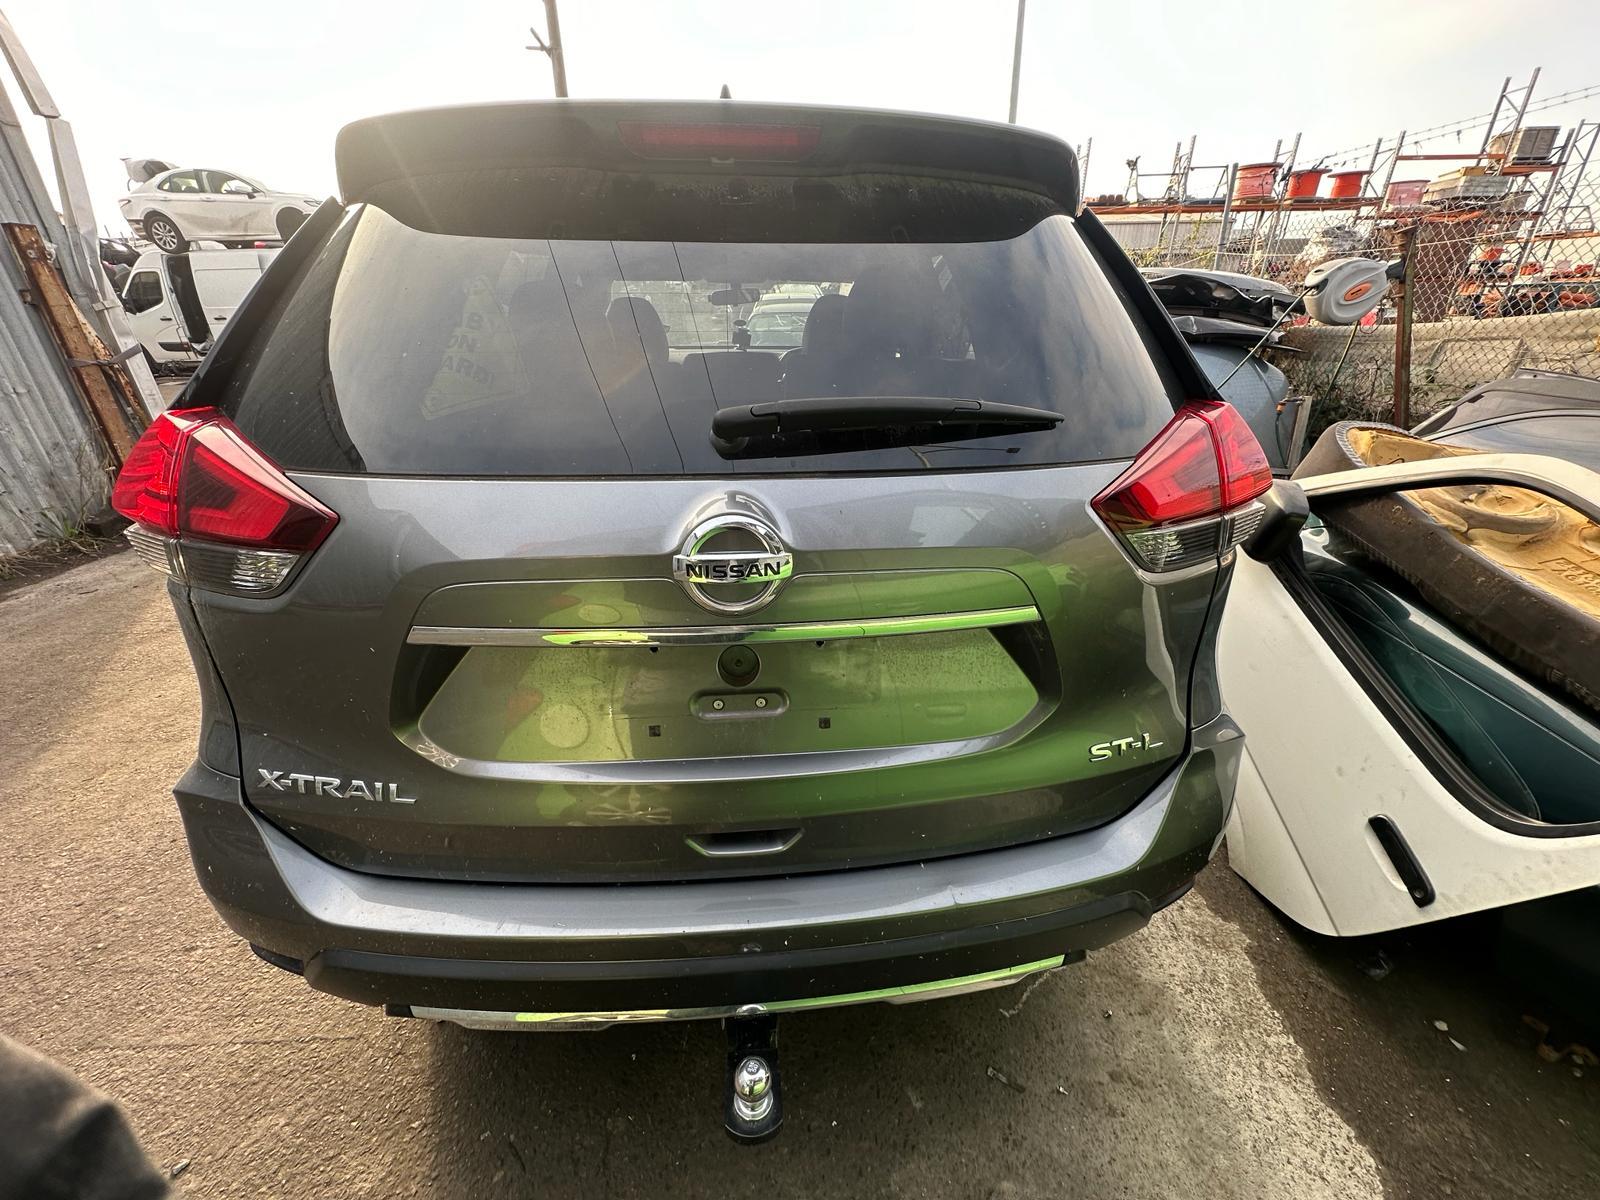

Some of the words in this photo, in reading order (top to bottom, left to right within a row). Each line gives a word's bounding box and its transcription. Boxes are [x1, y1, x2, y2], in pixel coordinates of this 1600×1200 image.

[685, 561, 781, 579] NISSAN
[1088, 732, 1164, 762] ST-L
[257, 768, 417, 804] X-TRAIL
